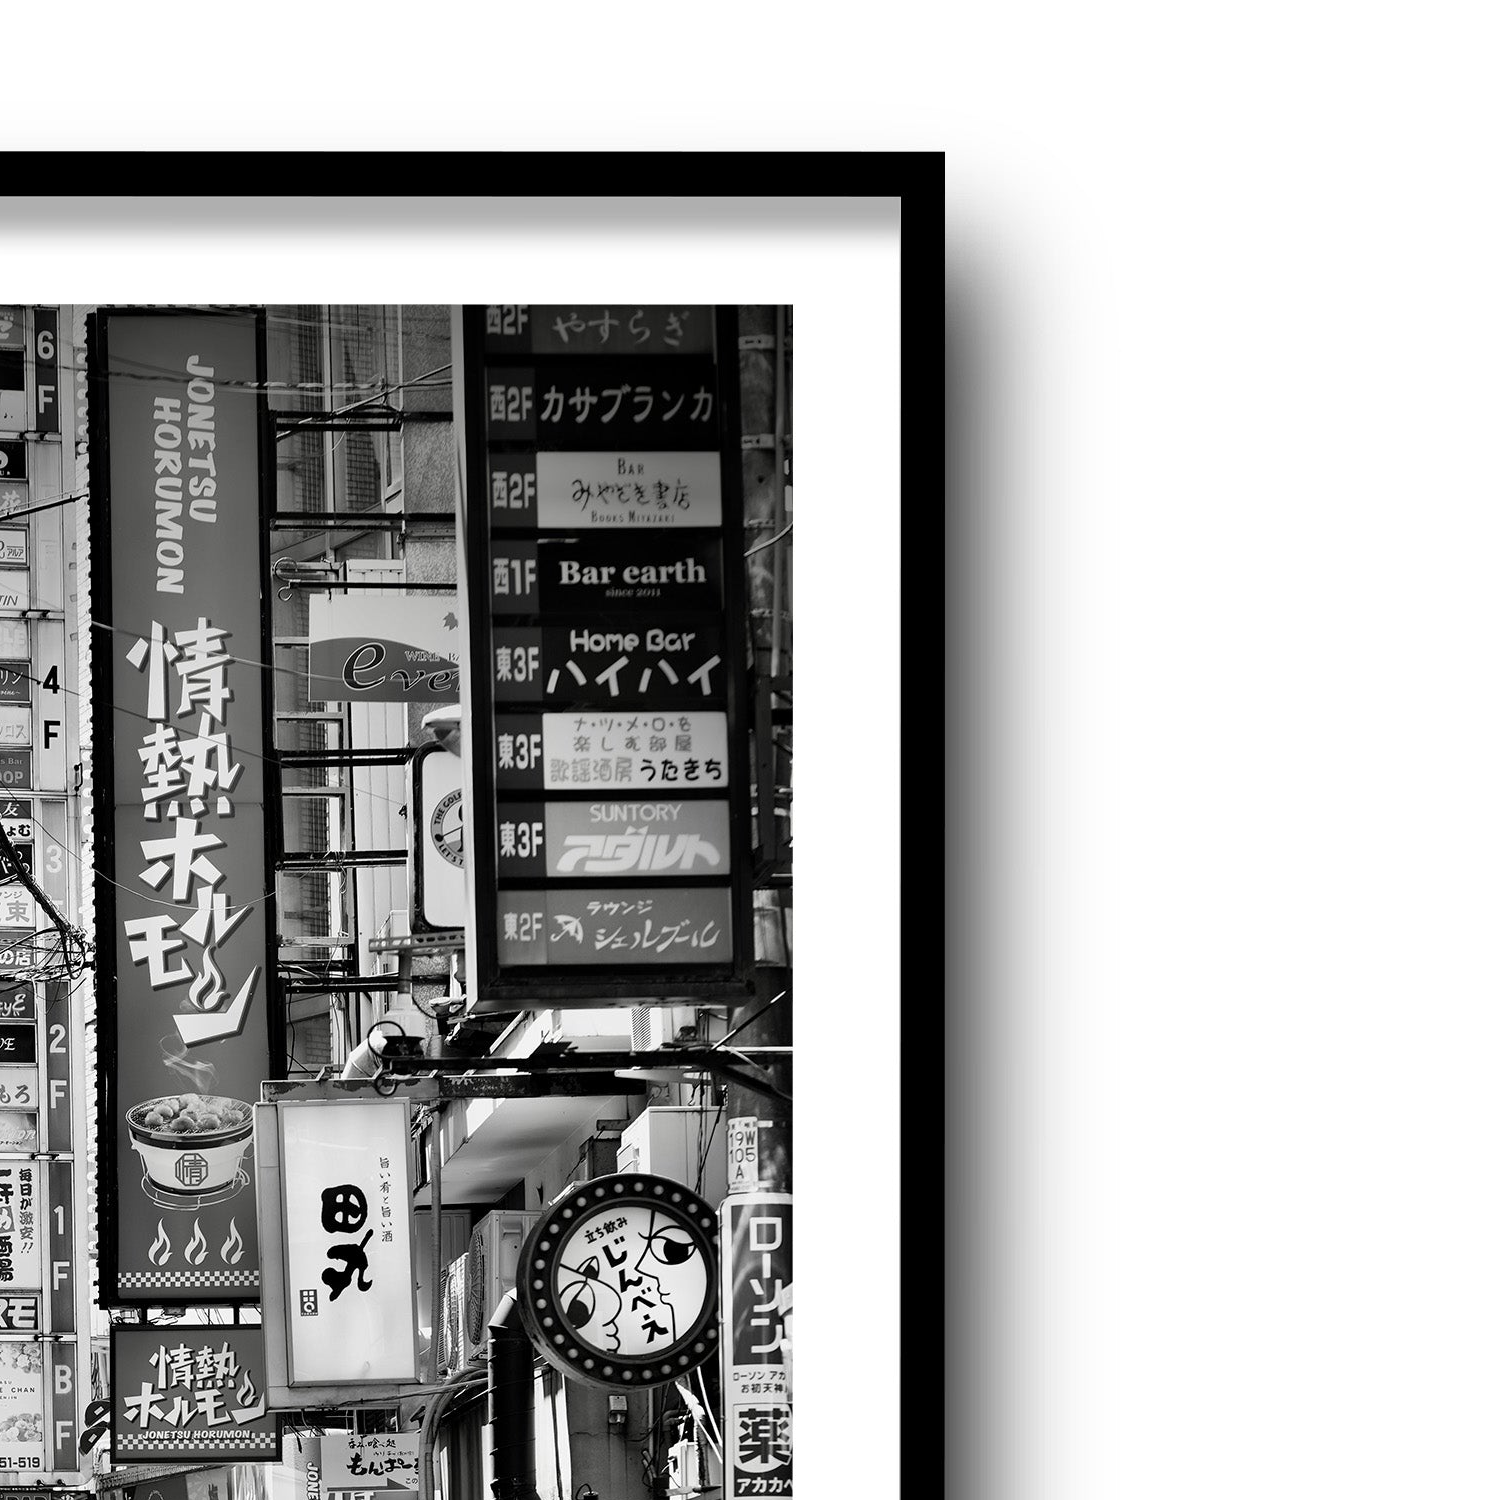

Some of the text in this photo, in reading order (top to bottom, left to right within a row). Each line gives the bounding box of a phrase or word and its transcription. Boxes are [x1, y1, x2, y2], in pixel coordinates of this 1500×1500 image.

[553, 309, 690, 347] やすらぎ
[490, 384, 713, 424] 西2F カサブランカ
[186, 354, 217, 523] JONETSU
[153, 397, 184, 594] HORUMON
[492, 471, 535, 509] 西2F
[493, 557, 707, 595] 西1F Bar earth
[570, 628, 696, 653] Home Bar
[495, 647, 721, 698] 東3F ハイハイ
[498, 733, 541, 770] 東3F
[640, 757, 722, 782] うたきち
[124, 616, 259, 1048] 情熱ホルモン
[589, 803, 682, 823] SUNTORY
[499, 822, 721, 872] 東3F アダルト
[503, 911, 543, 941] 東2F
[586, 900, 654, 916] ラウンジ
[735, 1165, 744, 1180] A
[584, 1216, 628, 1245] 立ち飲み
[602, 1235, 669, 1345] じんべえ
[749, 1216, 783, 1354] ローソン
[148, 1341, 241, 1390] 情熱
[732, 1371, 766, 1381] ローソン
[123, 1381, 265, 1429] ホルモン
[141, 1430, 251, 1440] JONETSU HORUMON
[738, 1407, 792, 1464] 薬
